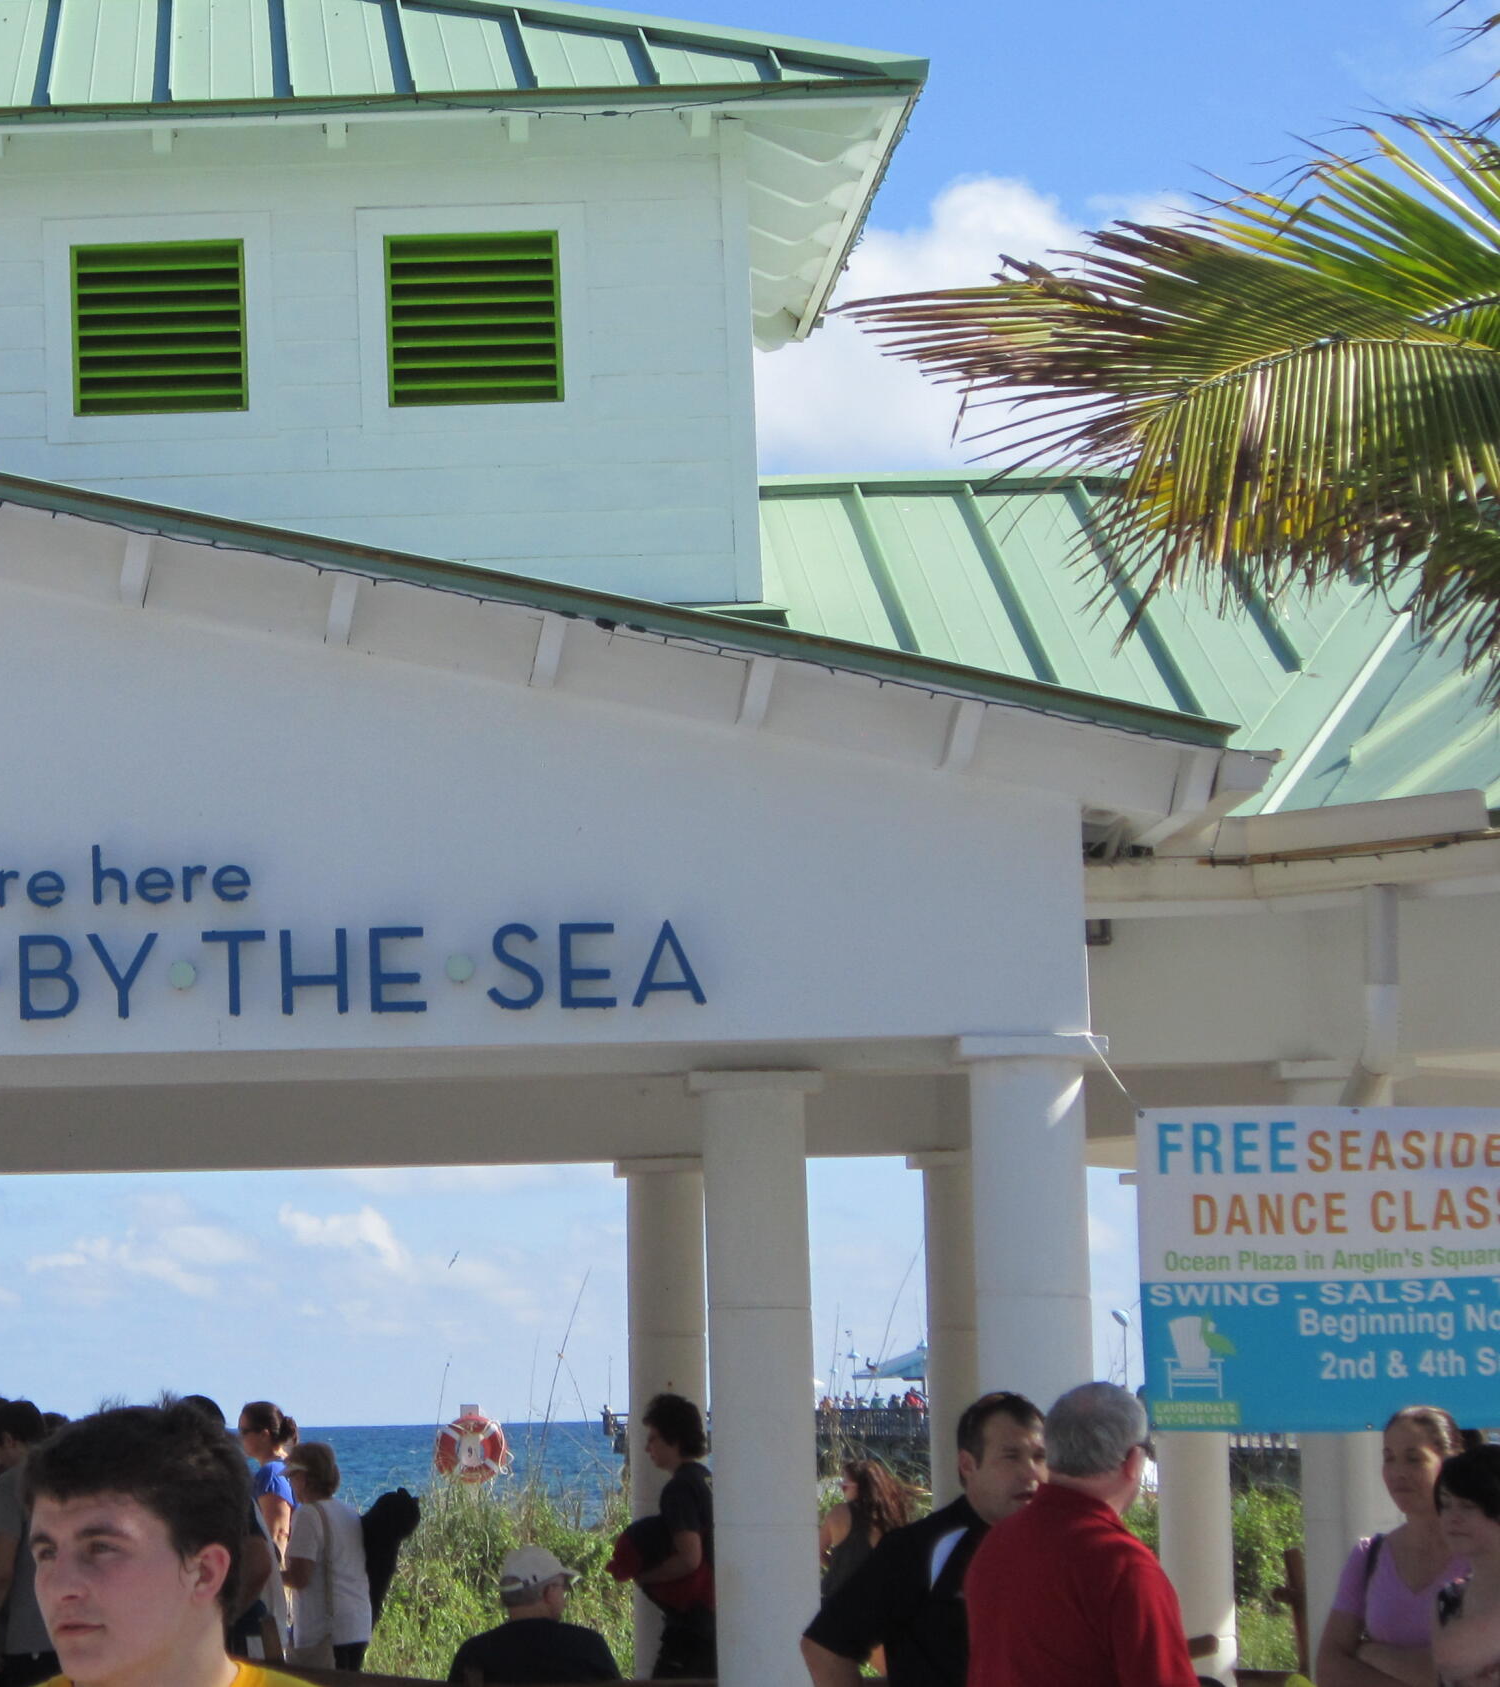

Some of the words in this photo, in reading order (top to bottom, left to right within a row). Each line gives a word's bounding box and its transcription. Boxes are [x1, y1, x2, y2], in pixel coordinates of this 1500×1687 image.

[91, 844, 251, 906] here
[18, 932, 158, 1022] BY
[201, 926, 428, 1016] THE
[486, 919, 708, 1010] SEA
[1157, 1121, 1298, 1175] FREE
[1307, 1129, 1500, 1173] SEASIDE
[1192, 1191, 1349, 1236] DANCE
[1370, 1186, 1500, 1233] CLAS
[1164, 1250, 1231, 1272] Ocean
[1238, 1250, 1297, 1272] Plaza
[1304, 1250, 1325, 1270] in
[1332, 1247, 1423, 1273] Anglin's
[1430, 1246, 1500, 1269] Squar
[1150, 1283, 1280, 1307] SWING
[1319, 1279, 1455, 1306] SALSA
[1298, 1305, 1455, 1343] Beginning
[1320, 1350, 1376, 1380] 2nd
[1386, 1349, 1409, 1379] &
[1418, 1348, 1467, 1377] 4th
[1477, 1346, 1500, 1376] S
